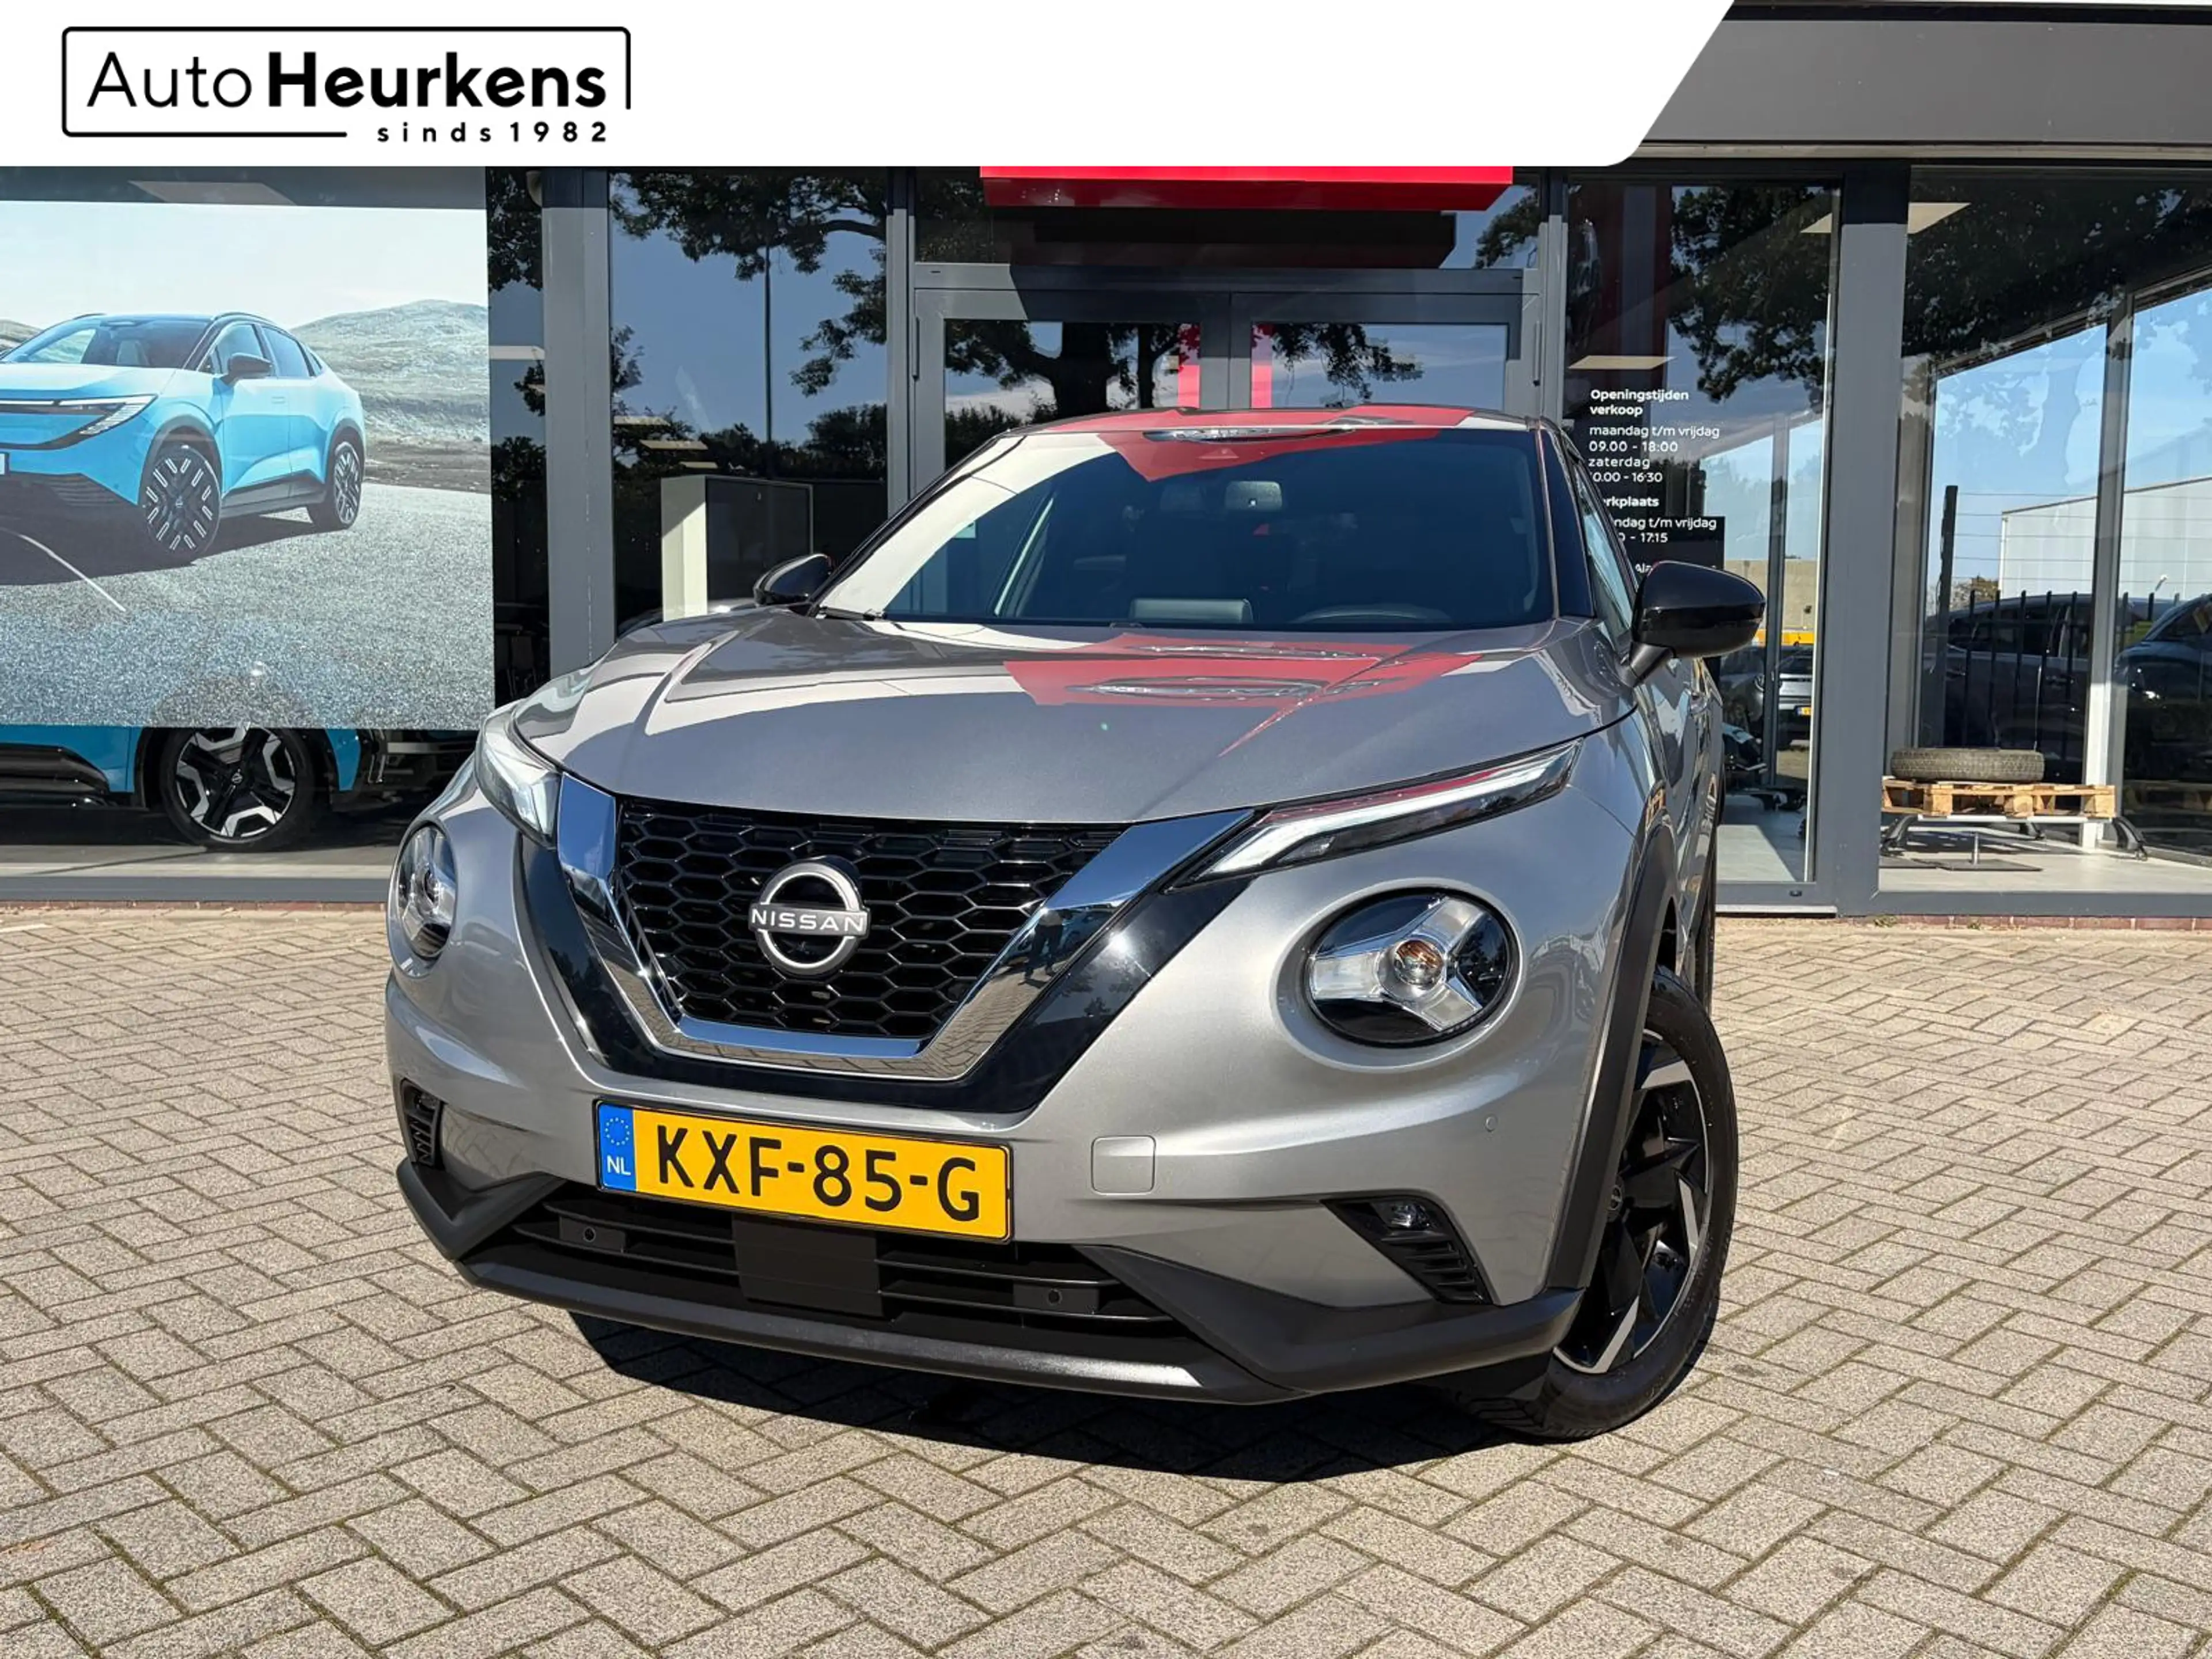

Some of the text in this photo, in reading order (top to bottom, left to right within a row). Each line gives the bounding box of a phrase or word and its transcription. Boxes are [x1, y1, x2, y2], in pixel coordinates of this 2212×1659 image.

[1590, 389, 1689, 402] Openingstijden
[1589, 404, 1643, 416] verkoop
[1589, 426, 1719, 439] maandag t/m vrijdag
[1589, 441, 1628, 452] 09.00
[1642, 441, 1678, 452] 18:00
[1588, 457, 1650, 469] zaterdag
[1604, 496, 1659, 509] rkplaats
[1614, 517, 1717, 531] ndag t/m vrijdag
[1641, 532, 1668, 543] 17.15
[751, 908, 864, 931] NISSAN
[607, 1124, 979, 1222] NL KXF-85-G
